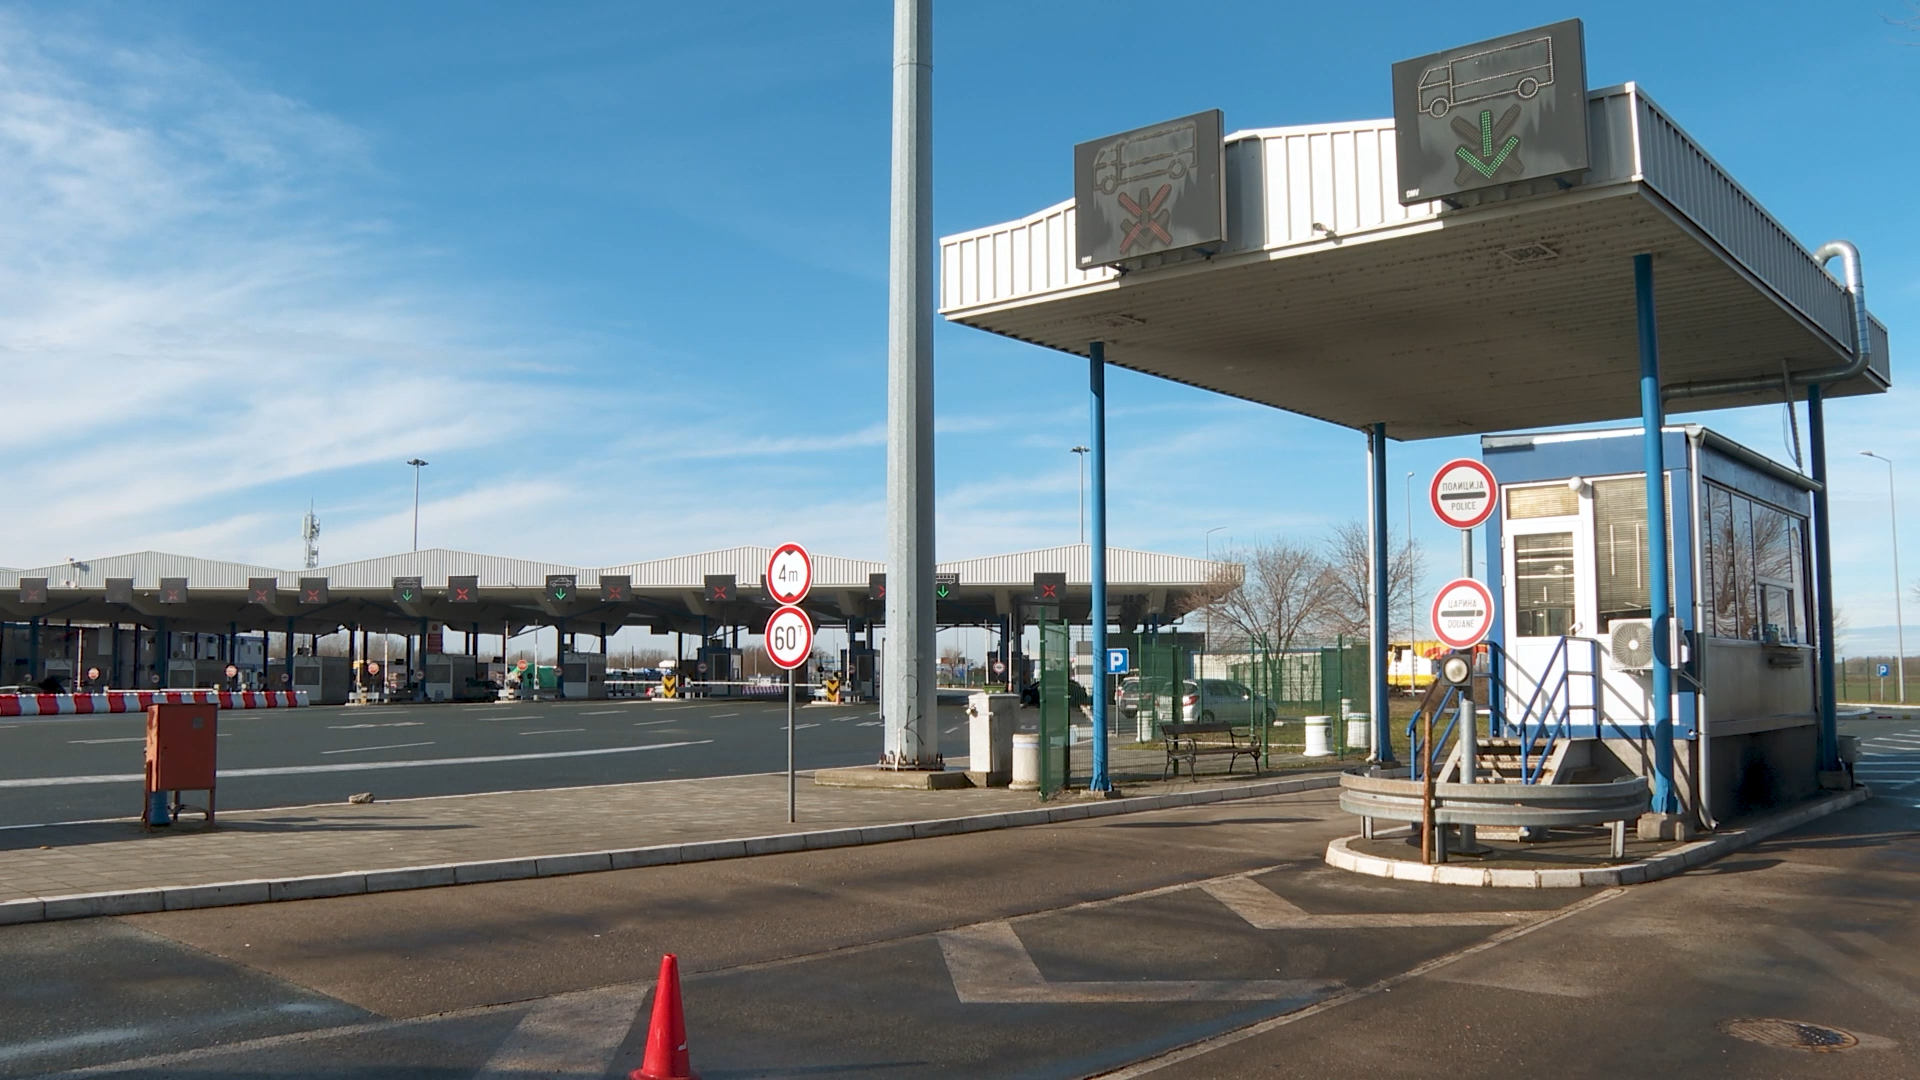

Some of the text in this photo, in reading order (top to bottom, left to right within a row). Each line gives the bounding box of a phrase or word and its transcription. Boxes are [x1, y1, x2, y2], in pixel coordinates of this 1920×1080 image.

[1442, 480, 1484, 491] ПОЛИЦИЈА
[1451, 501, 1477, 511] POLICE
[1447, 599, 1477, 609] ЦАРИНА
[1447, 619, 1475, 629] DOUANE
[1110, 652, 1124, 671] P
